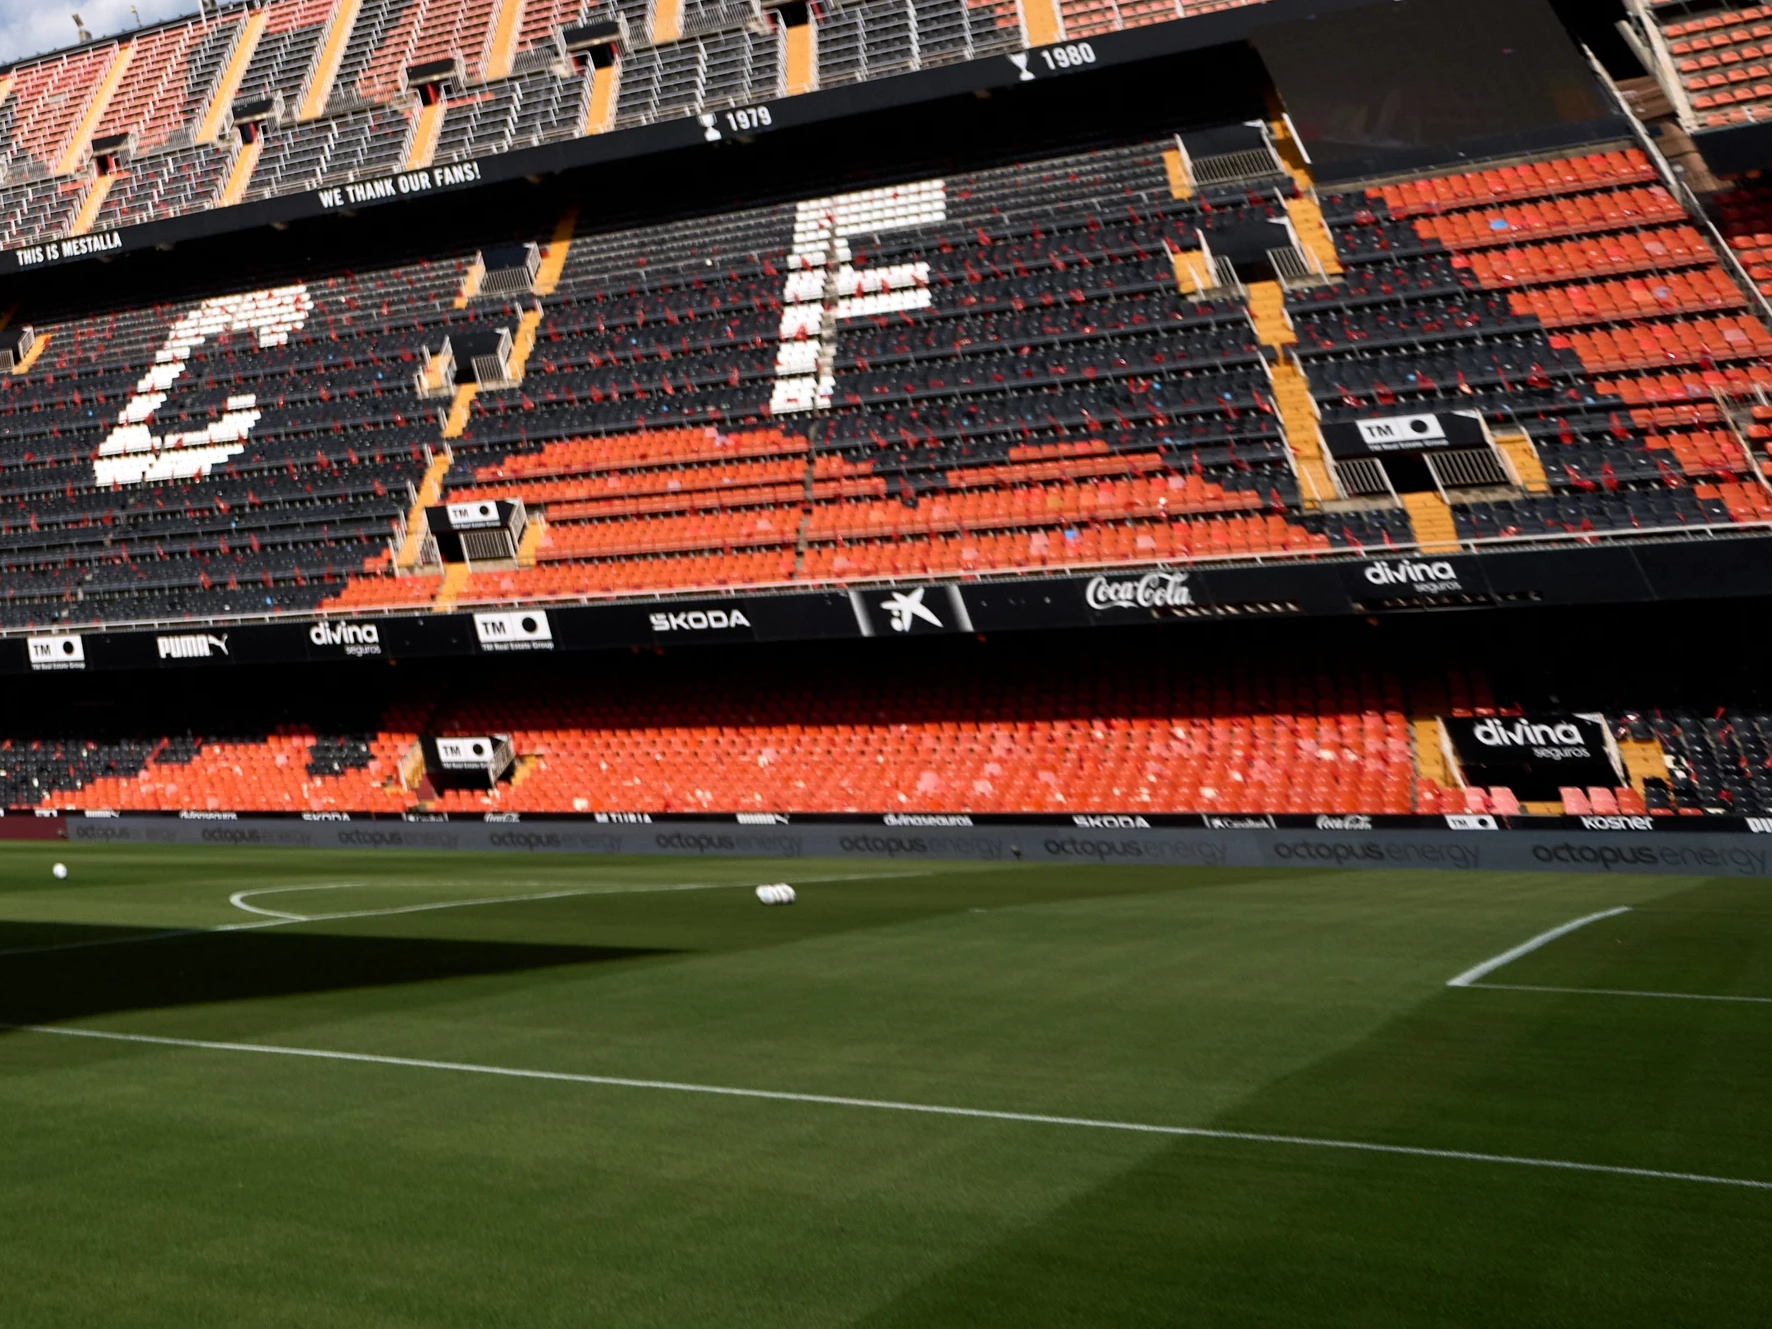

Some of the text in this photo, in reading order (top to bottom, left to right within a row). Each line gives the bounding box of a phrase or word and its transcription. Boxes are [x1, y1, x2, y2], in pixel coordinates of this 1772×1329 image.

[1040, 42, 1096, 71] 1980
[726, 105, 772, 132] 1979
[318, 161, 481, 209] WE THANK OUR FANS!
[15, 231, 123, 266] THIS IS MESTALLA
[1365, 424, 1394, 438] TM
[452, 509, 469, 519] TM
[1364, 558, 1457, 584] divina
[1415, 578, 1462, 595] seguros
[310, 620, 378, 646] divina
[482, 621, 506, 635] TM
[33, 644, 51, 657] TM
[157, 635, 210, 659] PUMA
[344, 643, 381, 657] seguros
[1473, 715, 1585, 747] divina
[443, 746, 461, 757] TM
[1532, 746, 1591, 761] seguros
